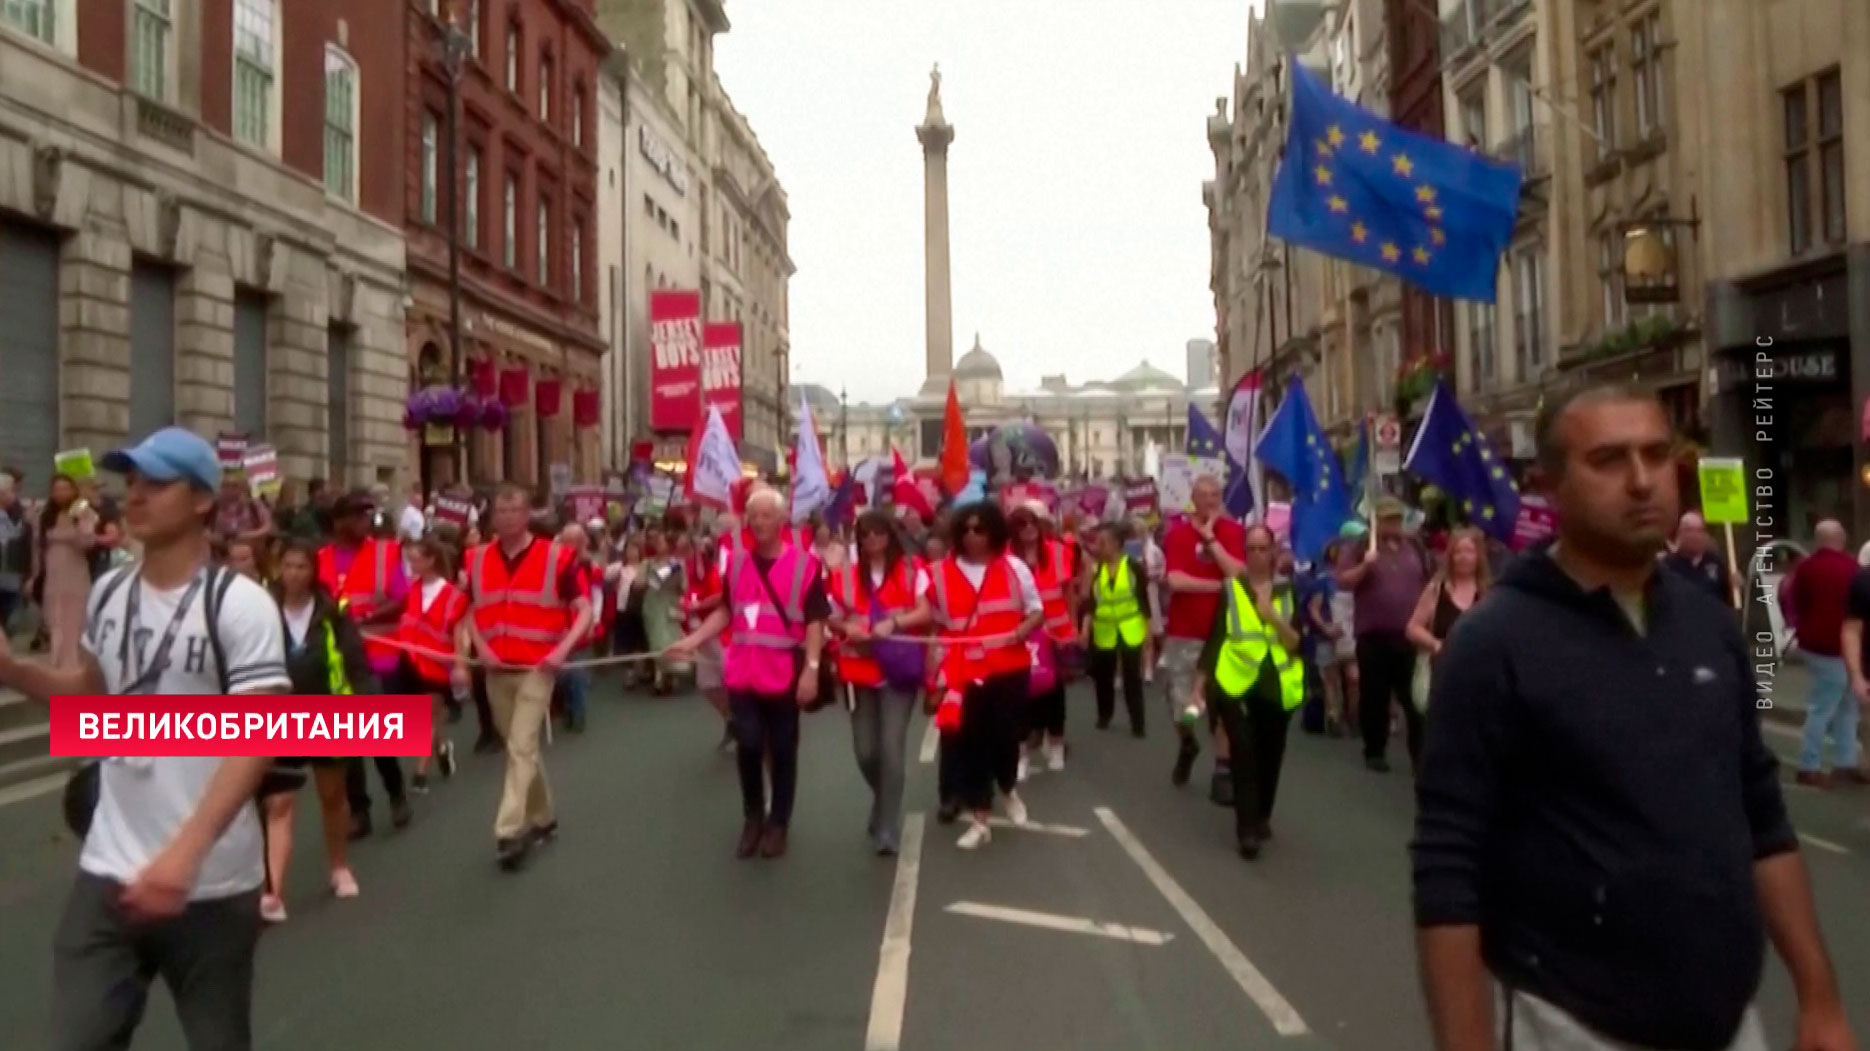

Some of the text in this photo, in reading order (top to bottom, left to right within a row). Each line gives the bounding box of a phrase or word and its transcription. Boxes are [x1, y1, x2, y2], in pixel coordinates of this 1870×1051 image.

[651, 319, 700, 344] JERSEY
[655, 338, 700, 370] BOYS
[702, 364, 741, 391] BOYS
